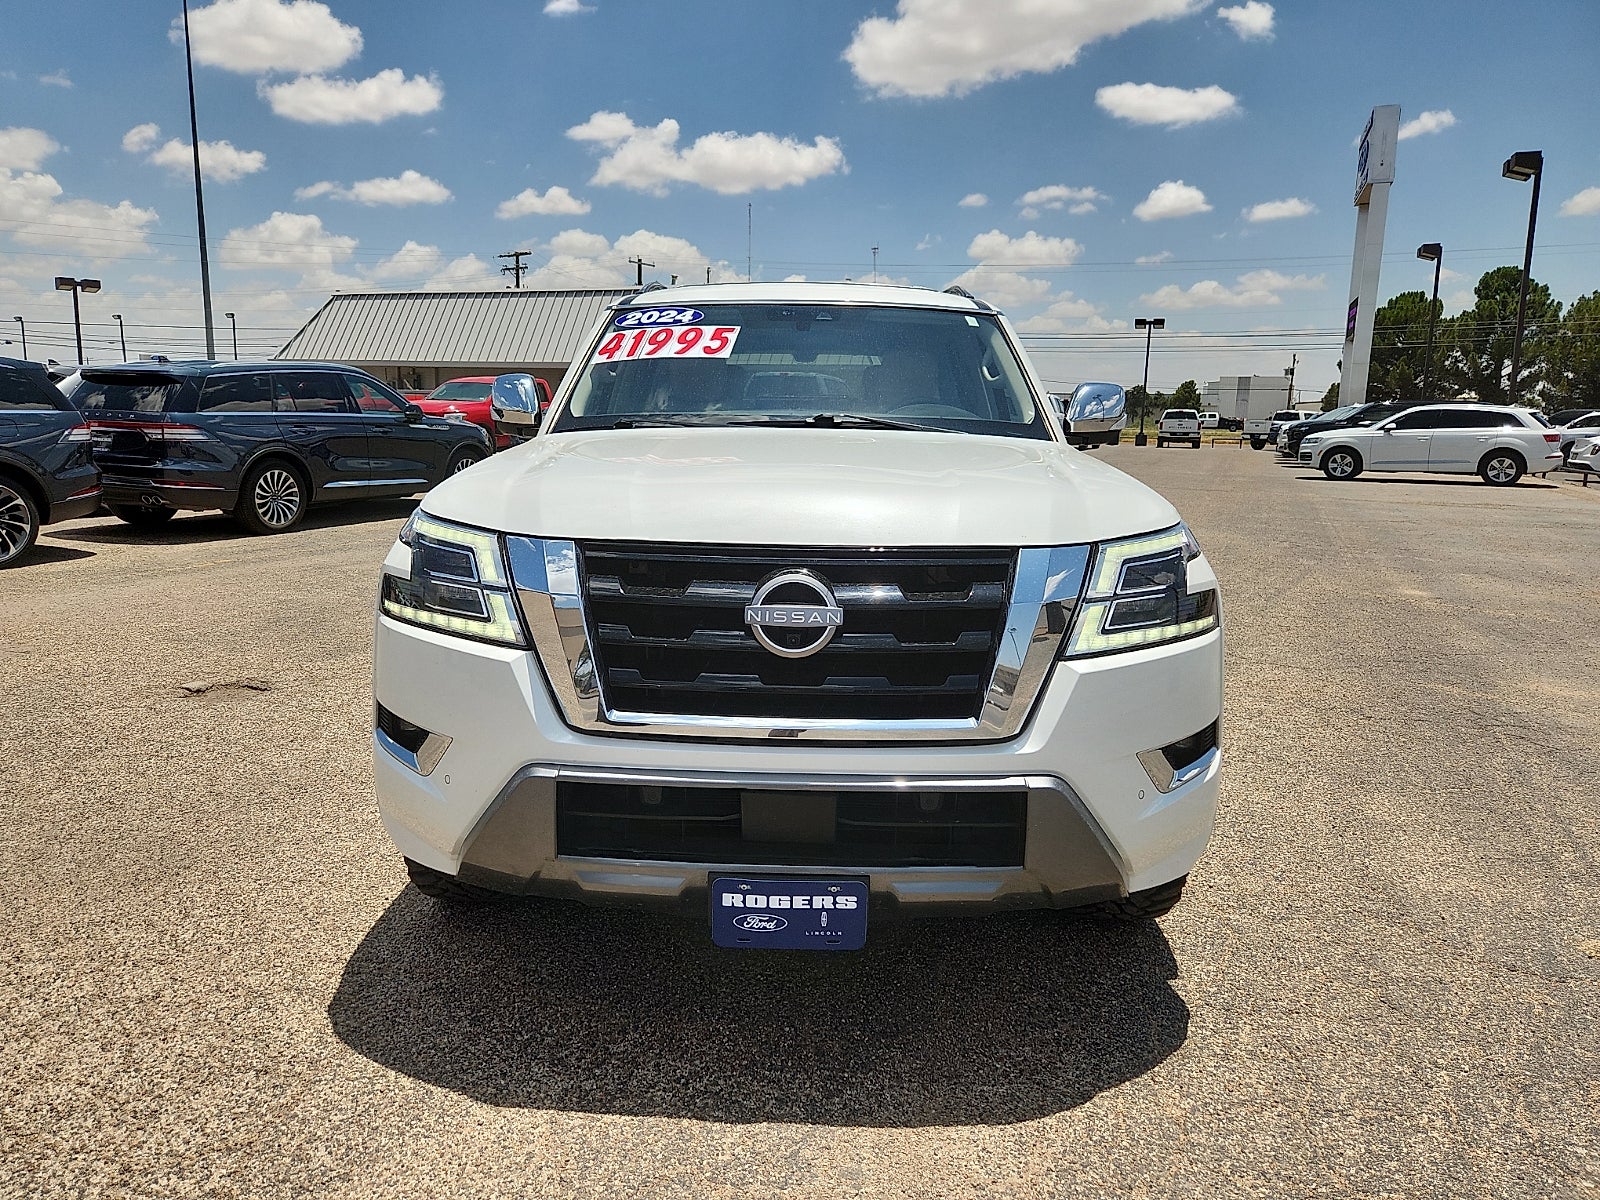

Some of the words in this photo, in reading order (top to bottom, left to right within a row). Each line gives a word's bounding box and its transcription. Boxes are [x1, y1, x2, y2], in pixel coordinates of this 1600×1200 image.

[621, 309, 695, 326] 2024
[598, 327, 736, 360] 41995
[747, 609, 841, 624] NISSAN
[721, 893, 858, 910] ROGERS
[743, 915, 777, 930] Ford
